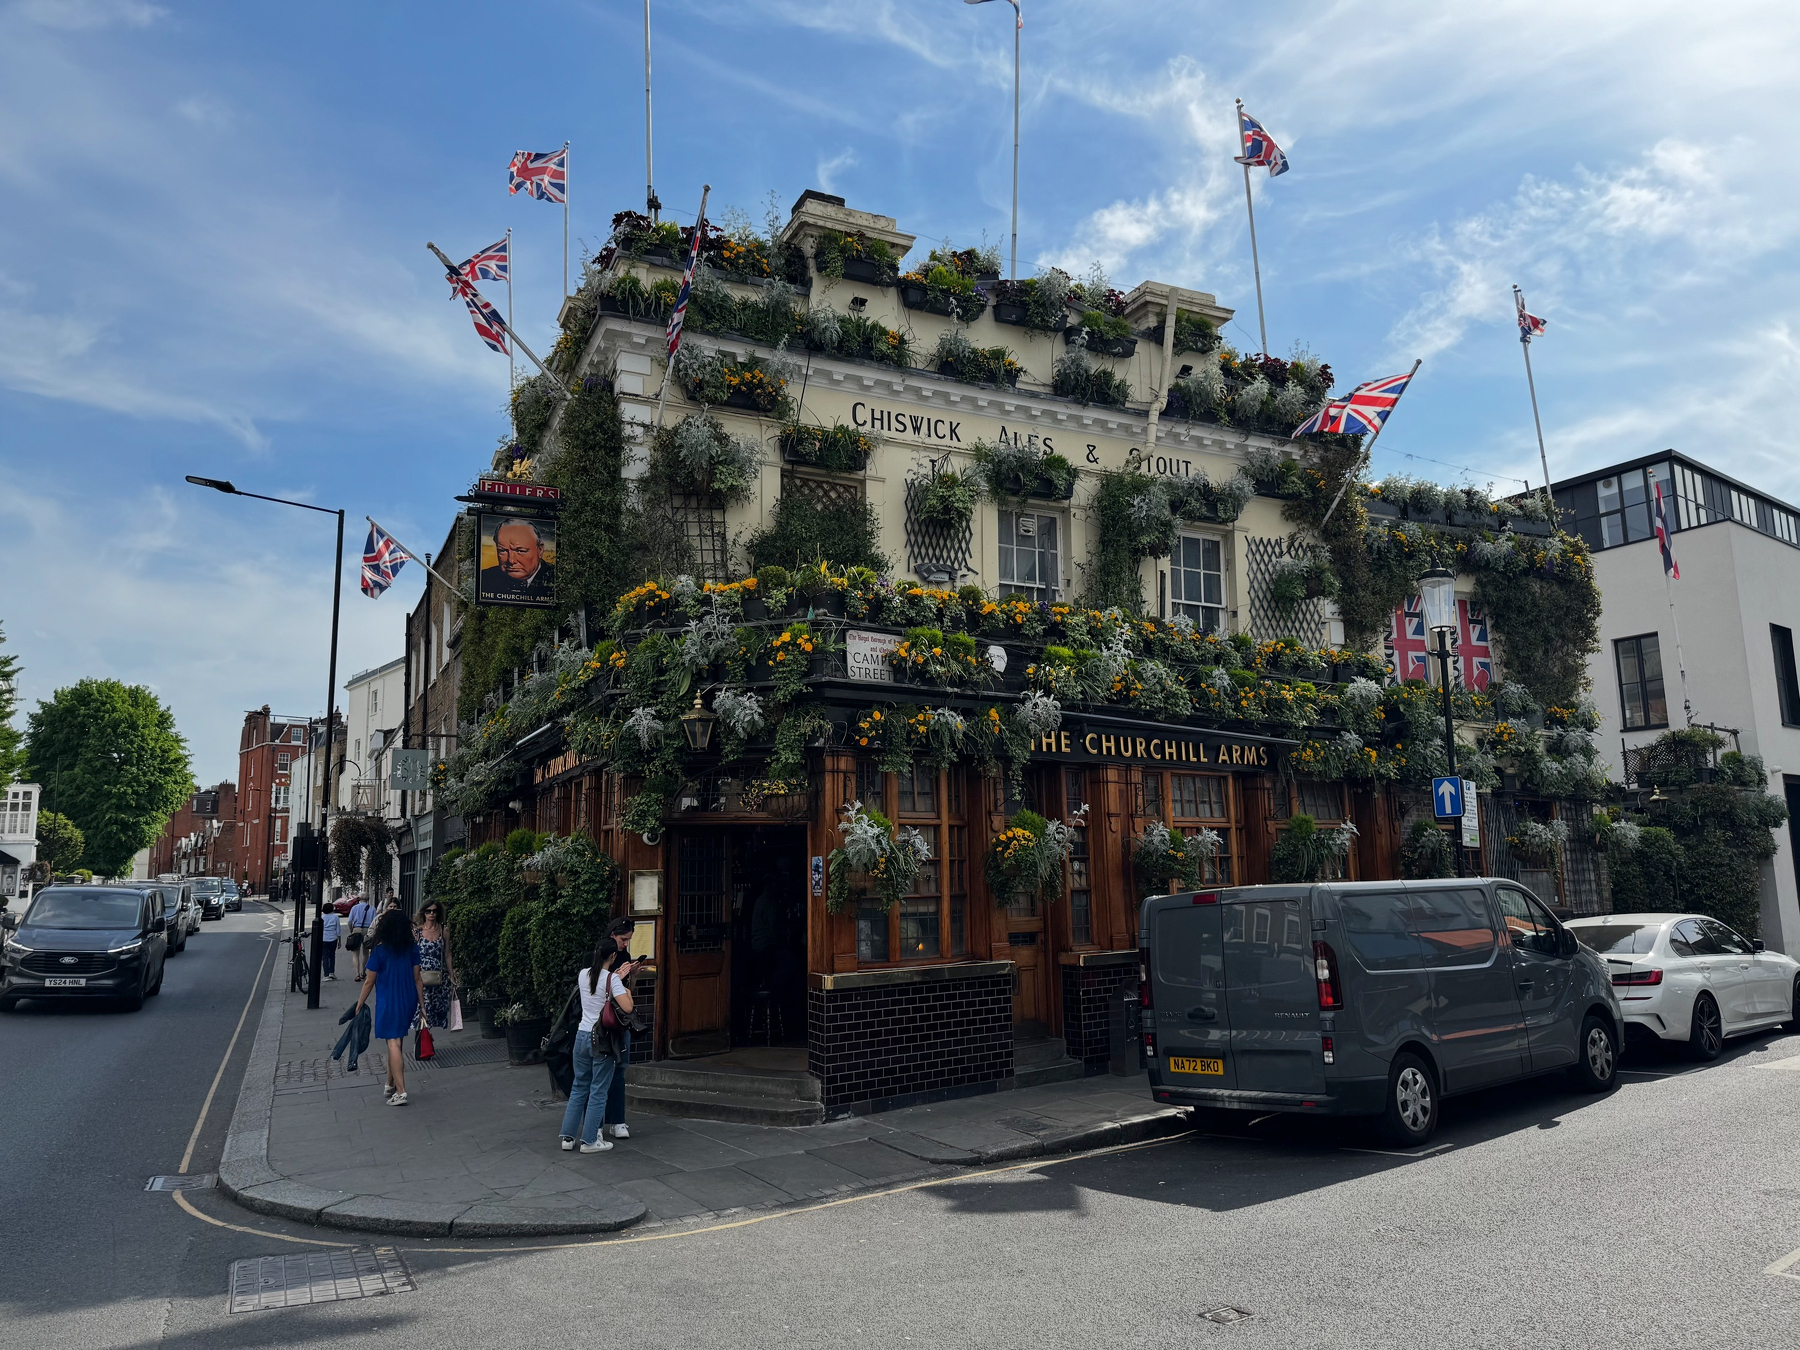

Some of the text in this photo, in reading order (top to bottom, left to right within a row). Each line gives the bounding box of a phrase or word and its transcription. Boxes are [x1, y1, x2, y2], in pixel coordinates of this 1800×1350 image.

[851, 402, 962, 443] CHISWICK
[1086, 443, 1100, 465] &
[496, 593, 534, 602] CHURCHILL
[853, 651, 893, 667] CAMP
[849, 665, 893, 681] STREET
[1084, 732, 1209, 763] CHURCHILL
[1217, 744, 1269, 767] ARMS
[1173, 1058, 1219, 1073] NA72 BKO
